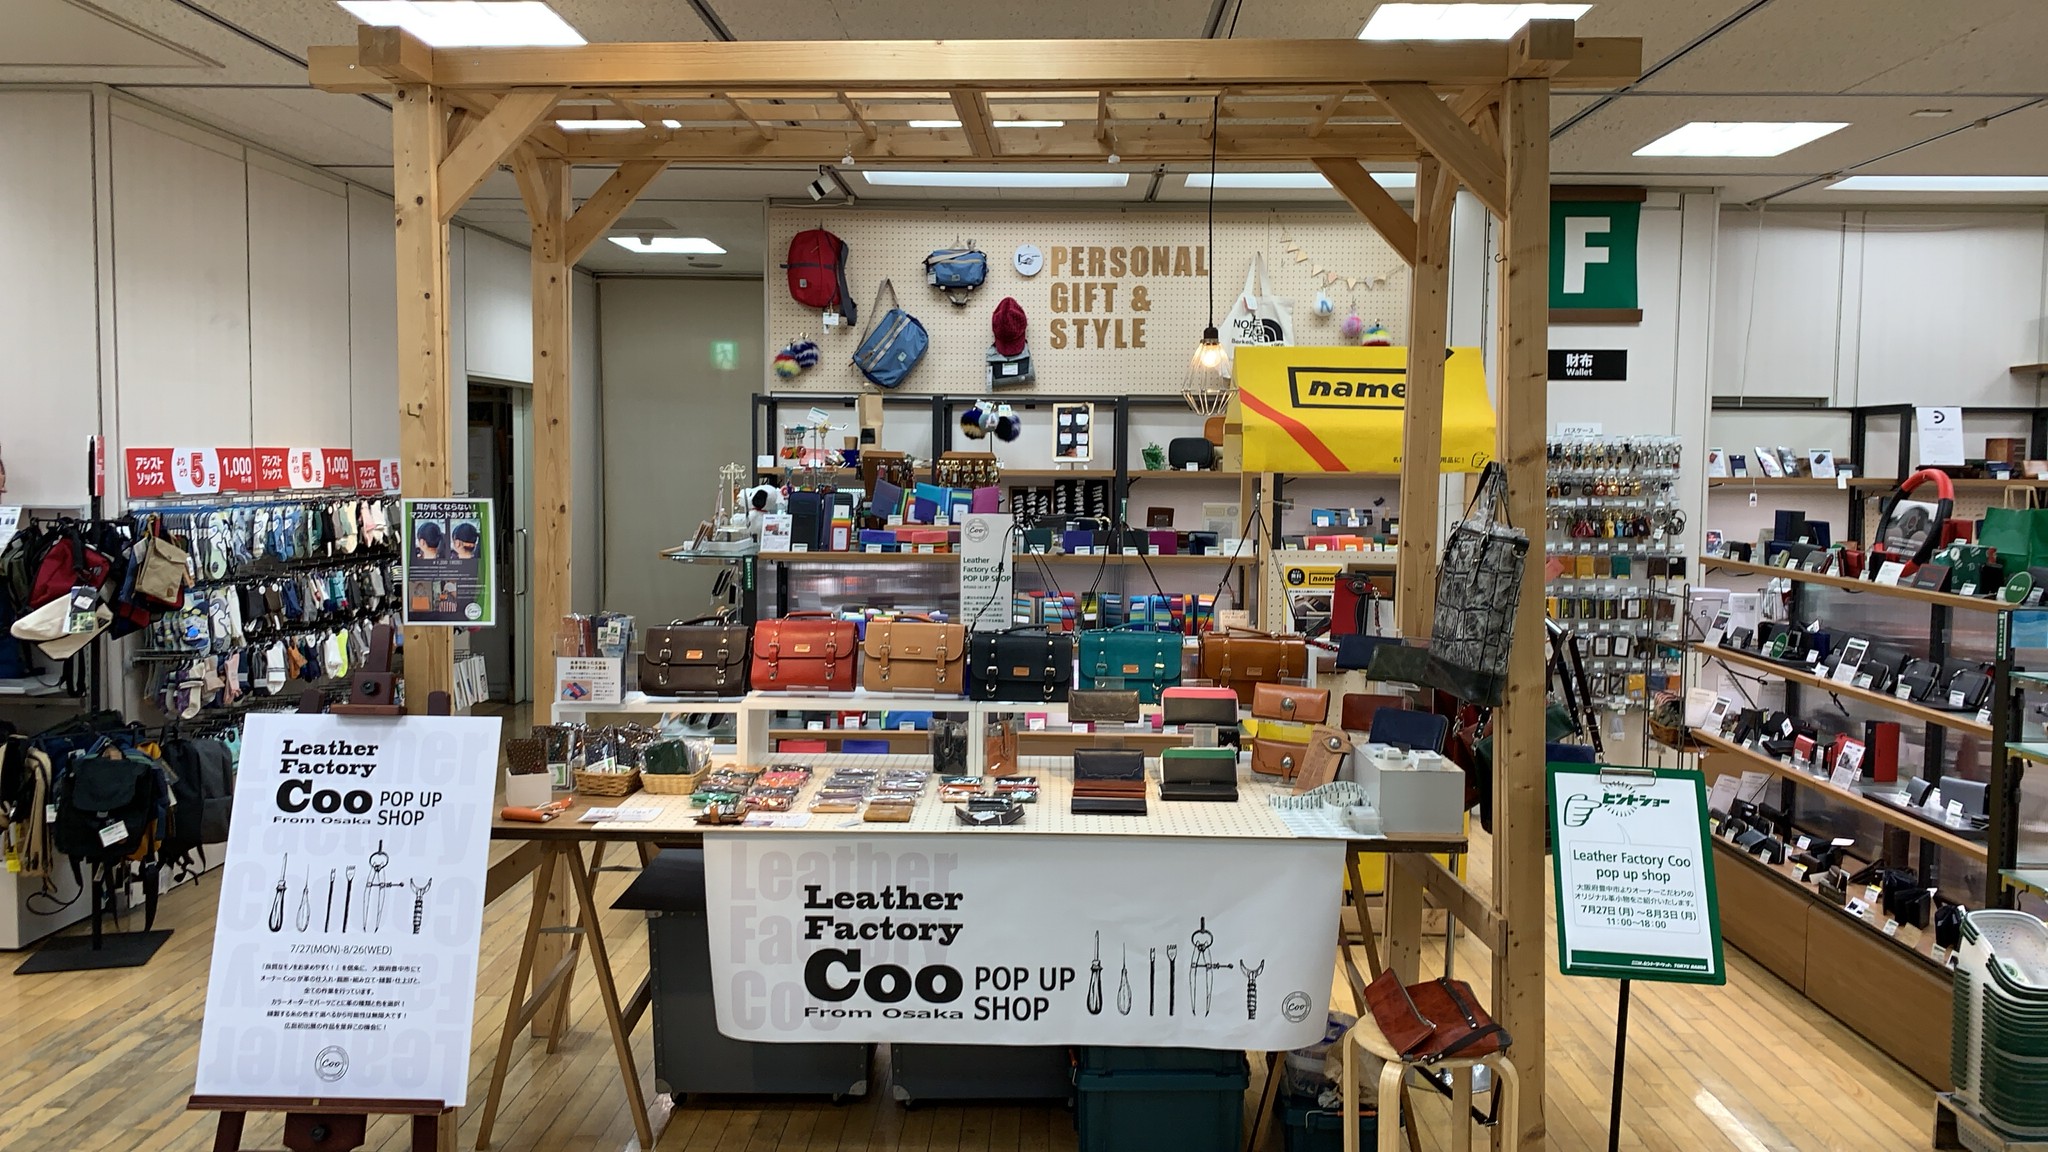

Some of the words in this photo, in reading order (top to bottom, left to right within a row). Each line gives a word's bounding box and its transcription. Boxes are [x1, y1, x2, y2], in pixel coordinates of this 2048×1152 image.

[1051, 245, 1209, 278] PERSONAL
[1563, 217, 1610, 294] F
[1051, 282, 1118, 313] GIFT
[1131, 282, 1152, 312] &
[1050, 317, 1146, 349] STYLE
[1566, 353, 1593, 367] 財布
[1566, 367, 1592, 377] Wallet
[1308, 380, 1406, 398] name
[1564, 426, 1594, 434] パスケース
[136, 456, 164, 470] アシスト
[261, 455, 283, 467] アシスト
[302, 452, 312, 483] 5
[326, 456, 349, 475] 1,000
[190, 452, 204, 488] 5
[209, 473, 216, 487] 足
[222, 456, 252, 478] 1,000
[263, 468, 283, 480] ソックス
[390, 462, 400, 489] 5
[137, 472, 165, 486] ソックス
[416, 503, 476, 511] 耳が痛くならない！
[963, 566, 989, 574] Factory
[281, 739, 379, 756] Leather
[280, 759, 376, 778] Factory
[276, 779, 373, 814] Coo
[380, 791, 414, 807] POP
[419, 792, 442, 808] UP
[1602, 792, 1670, 807] ヒントショー
[273, 816, 315, 824] From
[321, 816, 371, 824] Osaka
[377, 810, 425, 826] SHOP
[1573, 850, 1618, 864] Leather
[1622, 852, 1664, 868] Factory
[1668, 855, 1691, 867] Coo
[1596, 868, 1619, 880] pop
[1624, 870, 1638, 882] up
[1642, 870, 1671, 884] shop
[804, 884, 964, 911] Leather
[1576, 884, 1694, 898] 大阪府豊中市よりオーナーこだわりの
[1575, 893, 1695, 907] オリジナル革小物をご紹介いたします。
[804, 914, 964, 946] Factory
[804, 947, 964, 1004] Coo
[976, 967, 1028, 991] POP
[1039, 967, 1075, 991] UP
[804, 1007, 872, 1019] From
[882, 1007, 963, 1020] Osaka
[974, 996, 1050, 1022] SHOP
[1288, 1002, 1305, 1012] Coo
